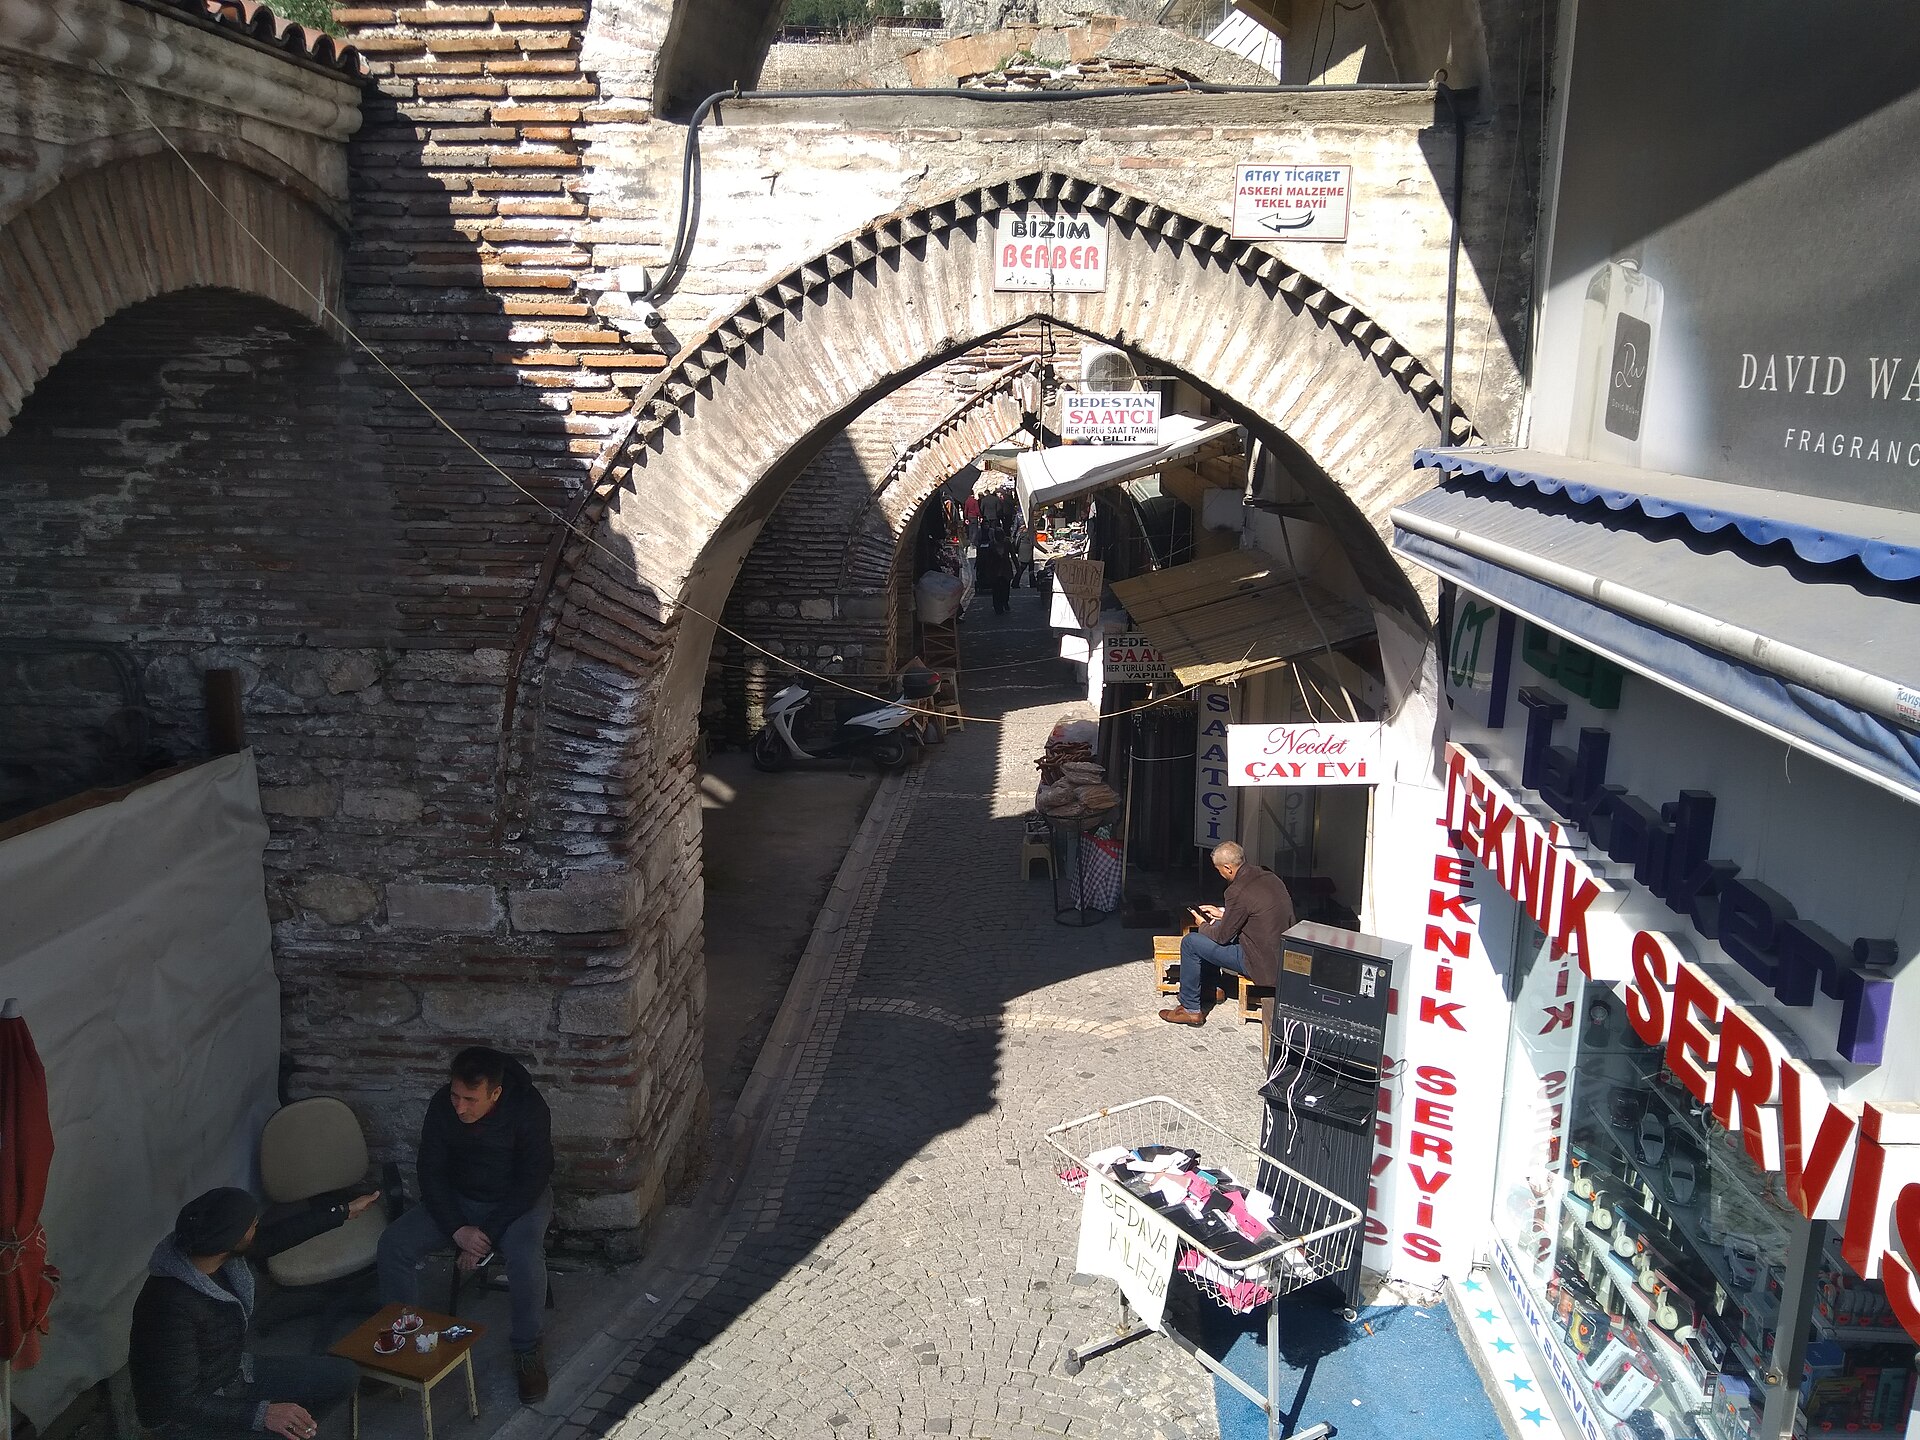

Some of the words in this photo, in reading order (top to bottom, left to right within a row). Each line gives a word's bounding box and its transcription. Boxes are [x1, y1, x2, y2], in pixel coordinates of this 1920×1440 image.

[1245, 170, 1280, 182] ATAY
[1285, 168, 1340, 182] TİCARET
[1239, 184, 1282, 196] ASKERİ
[1286, 187, 1344, 196] MALZEME
[1255, 199, 1292, 208] TEKEL
[1011, 214, 1091, 240] BİZİM
[1002, 243, 1099, 270] BERBER
[1738, 353, 1846, 396] DAVID
[1068, 397, 1155, 408] BEDESTAN
[1065, 426, 1080, 435] HER
[1107, 426, 1127, 435] SAAT
[1108, 637, 1152, 648] BEDE
[1106, 664, 1120, 672] HER
[1146, 663, 1167, 672] SAAT
[1263, 727, 1347, 754] Necdet
[1245, 762, 1307, 782] ÇAY
[1317, 758, 1367, 778] EVİ
[1445, 741, 1601, 982] TEKNİK
[1100, 1183, 1168, 1260] BEDAVA
